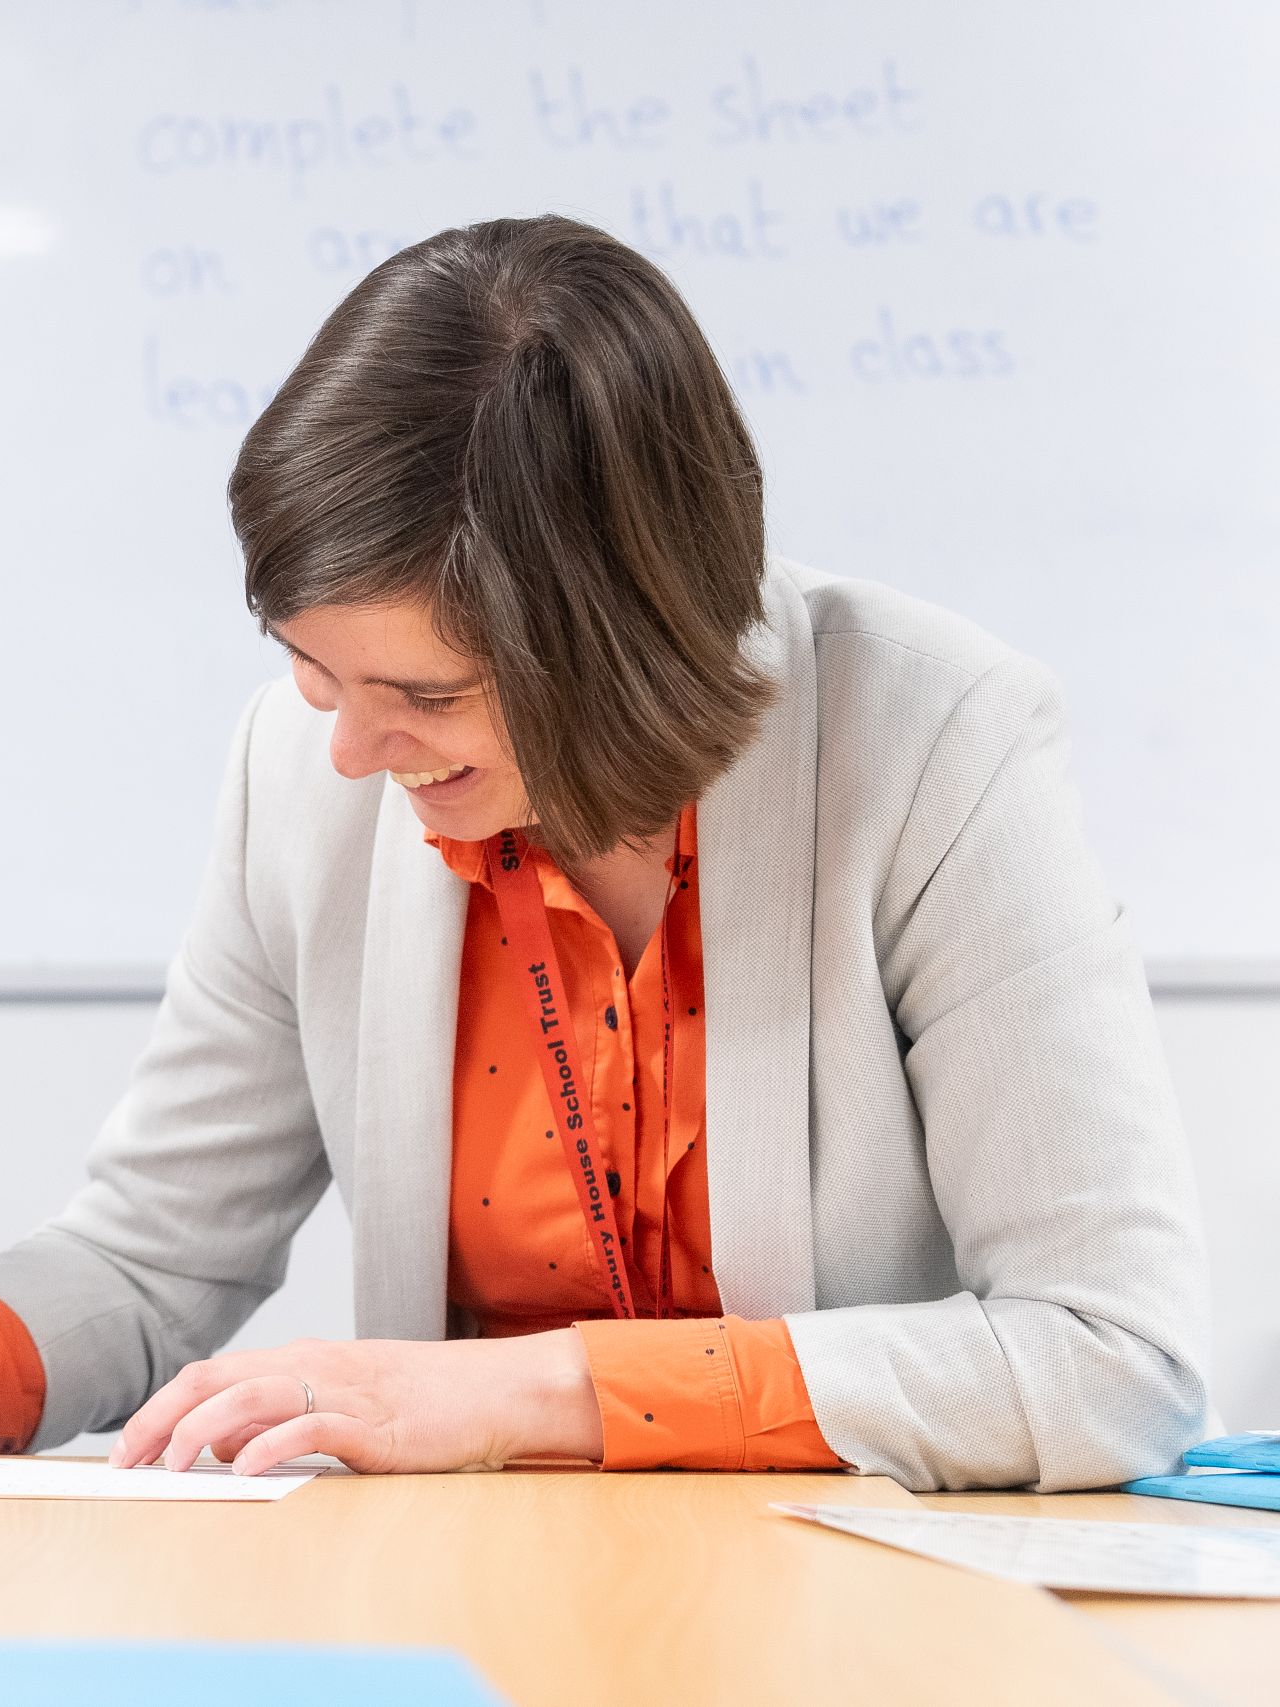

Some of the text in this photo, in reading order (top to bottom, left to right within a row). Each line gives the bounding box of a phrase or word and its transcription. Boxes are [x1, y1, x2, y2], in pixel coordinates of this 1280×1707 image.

[137, 50, 925, 201] complete the sheet
[141, 243, 240, 298] on
[631, 176, 787, 261] that
[835, 198, 924, 248] we
[972, 191, 1101, 246] are
[143, 304, 1015, 431] lea in class
[528, 962, 559, 1034] Trust
[547, 1040, 583, 1130] School
[576, 1138, 605, 1222] House
